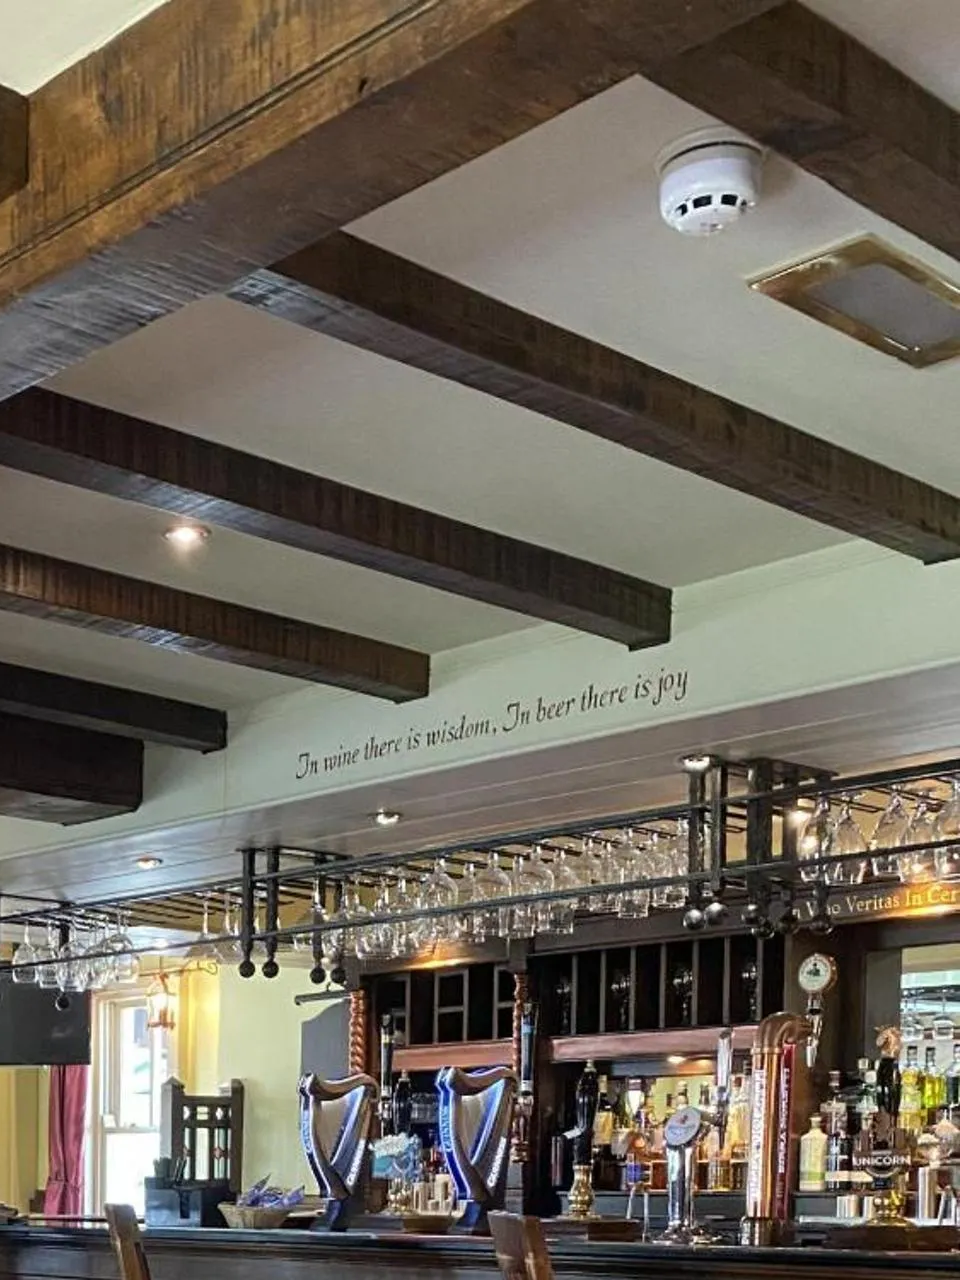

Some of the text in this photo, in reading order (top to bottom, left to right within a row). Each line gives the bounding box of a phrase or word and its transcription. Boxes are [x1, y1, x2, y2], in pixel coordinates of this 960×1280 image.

[295, 668, 689, 779] In wine there is wisdom, In beer there is joy
[846, 894, 901, 914] Veritas
[905, 889, 922, 907] In
[851, 1154, 912, 1167] UNICORN
